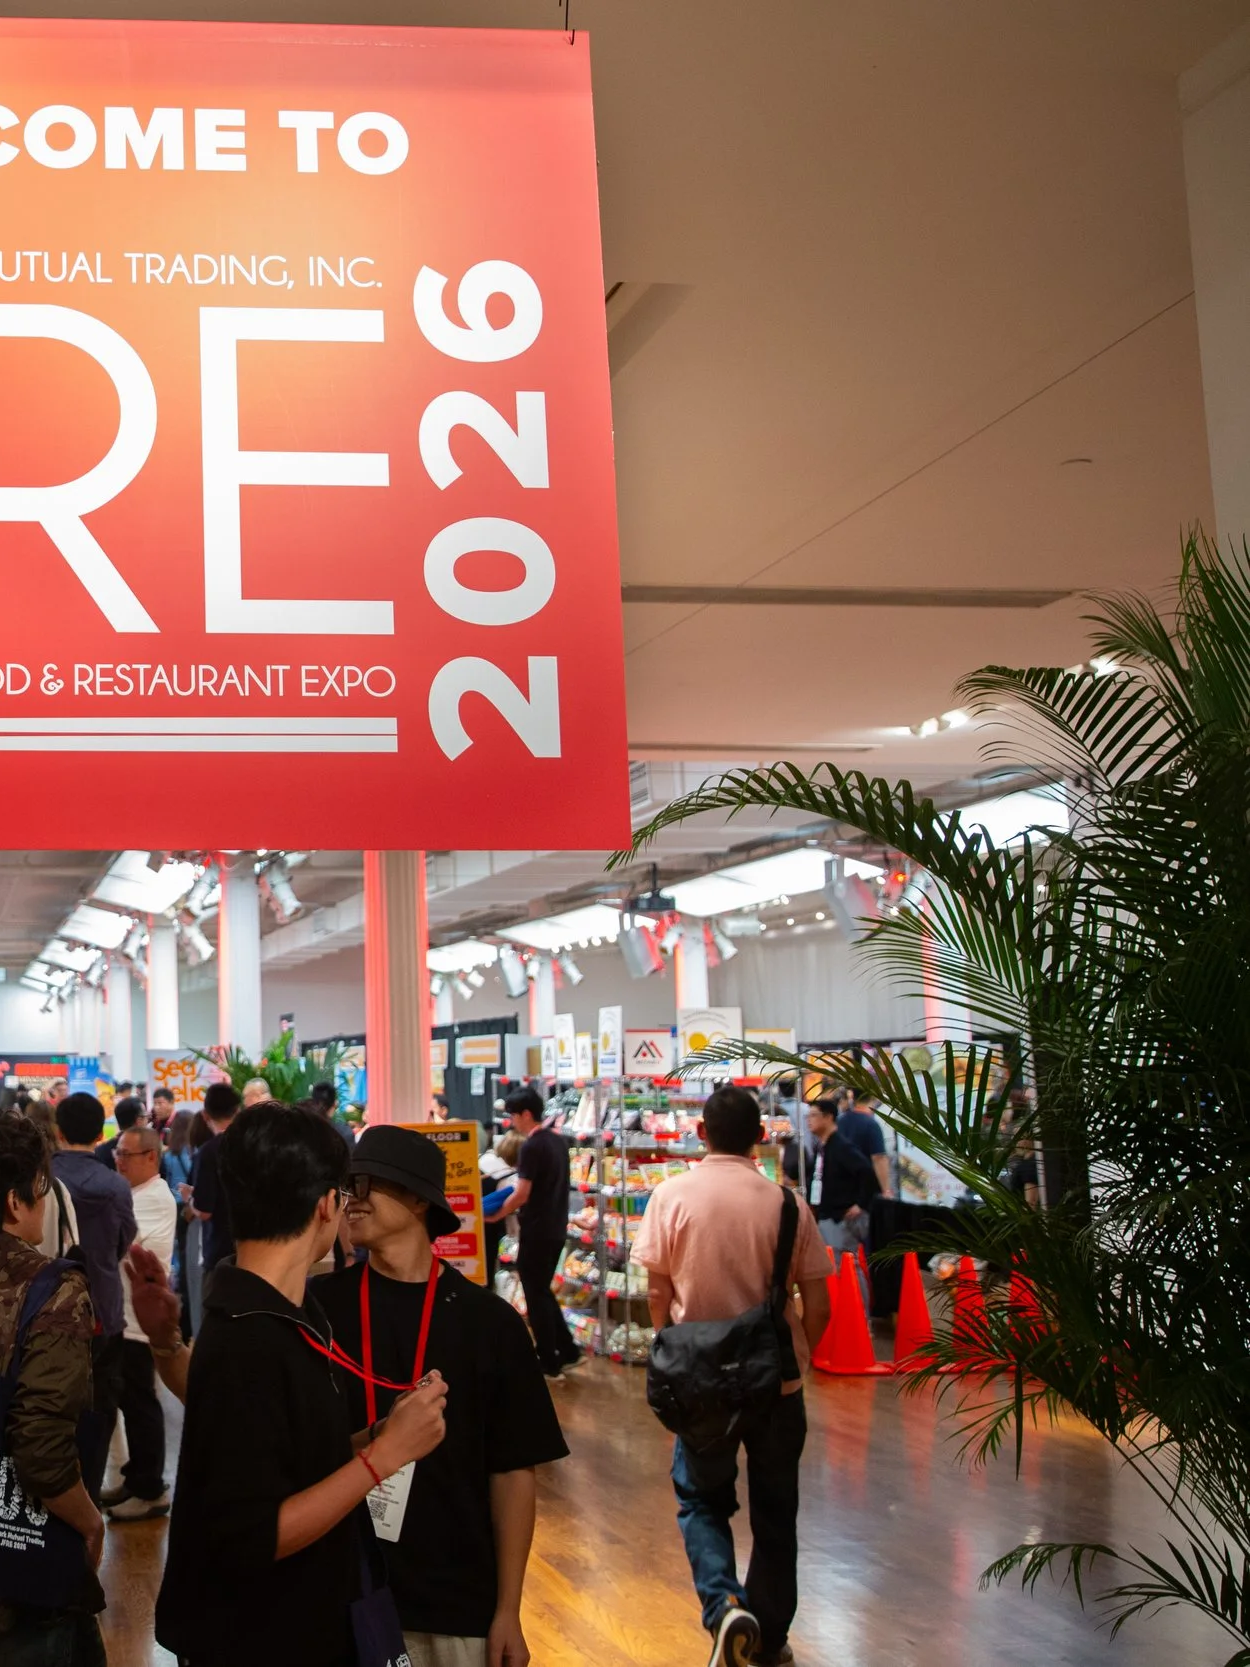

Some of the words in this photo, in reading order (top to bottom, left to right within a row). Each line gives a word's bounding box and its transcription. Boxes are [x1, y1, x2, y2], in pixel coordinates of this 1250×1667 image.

[278, 110, 409, 175] TO
[124, 253, 294, 289] TRADING,
[309, 256, 382, 288] INC.
[413, 259, 562, 761] 2026
[40, 663, 64, 696] &
[74, 663, 290, 697] RESTAURANT
[301, 665, 396, 698] EXPO
[153, 1057, 198, 1081] Sea
[7, 1531, 25, 1542] Mutual
[26, 1535, 45, 1548] Trading
